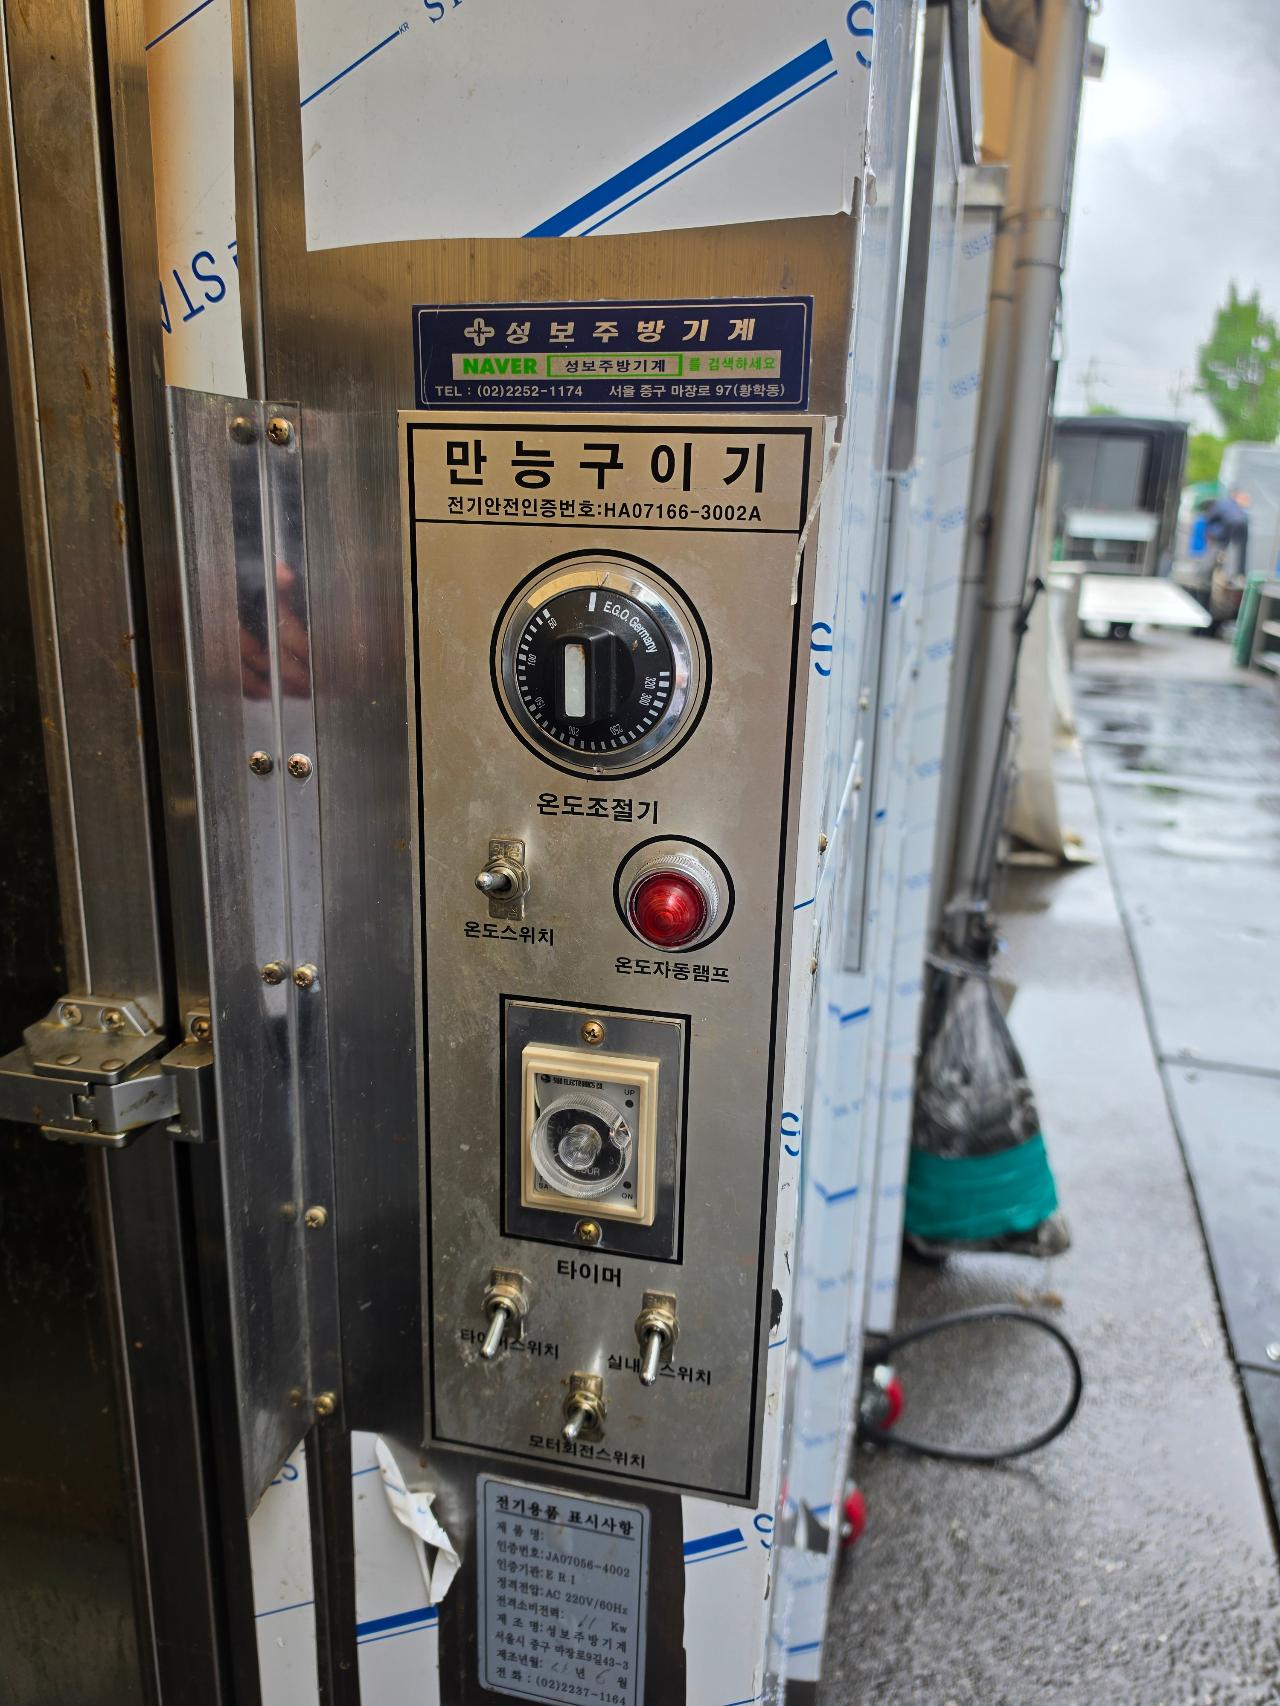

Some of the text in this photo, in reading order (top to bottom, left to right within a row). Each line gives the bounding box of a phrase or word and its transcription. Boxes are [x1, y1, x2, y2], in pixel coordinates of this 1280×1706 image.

[463, 356, 776, 375] NAVER 성보주방기계 를 검색하세요
[477, 384, 583, 398] (02)2252-1174
[609, 385, 635, 398] 서울
[640, 385, 666, 398] 중구
[671, 384, 711, 397] 마장로
[715, 383, 785, 397] 97(황학동)
[629, 616, 658, 653] Germany
[537, 792, 659, 825] 온도조절기
[463, 921, 555, 946] 온도스위치
[614, 956, 731, 983] 온도자동램프
[557, 1260, 622, 1288] 타이머
[608, 1354, 711, 1386] 실내스위치
[529, 1435, 645, 1469] 모터회전스위치
[496, 1495, 634, 1536] 전기용품 표시사항
